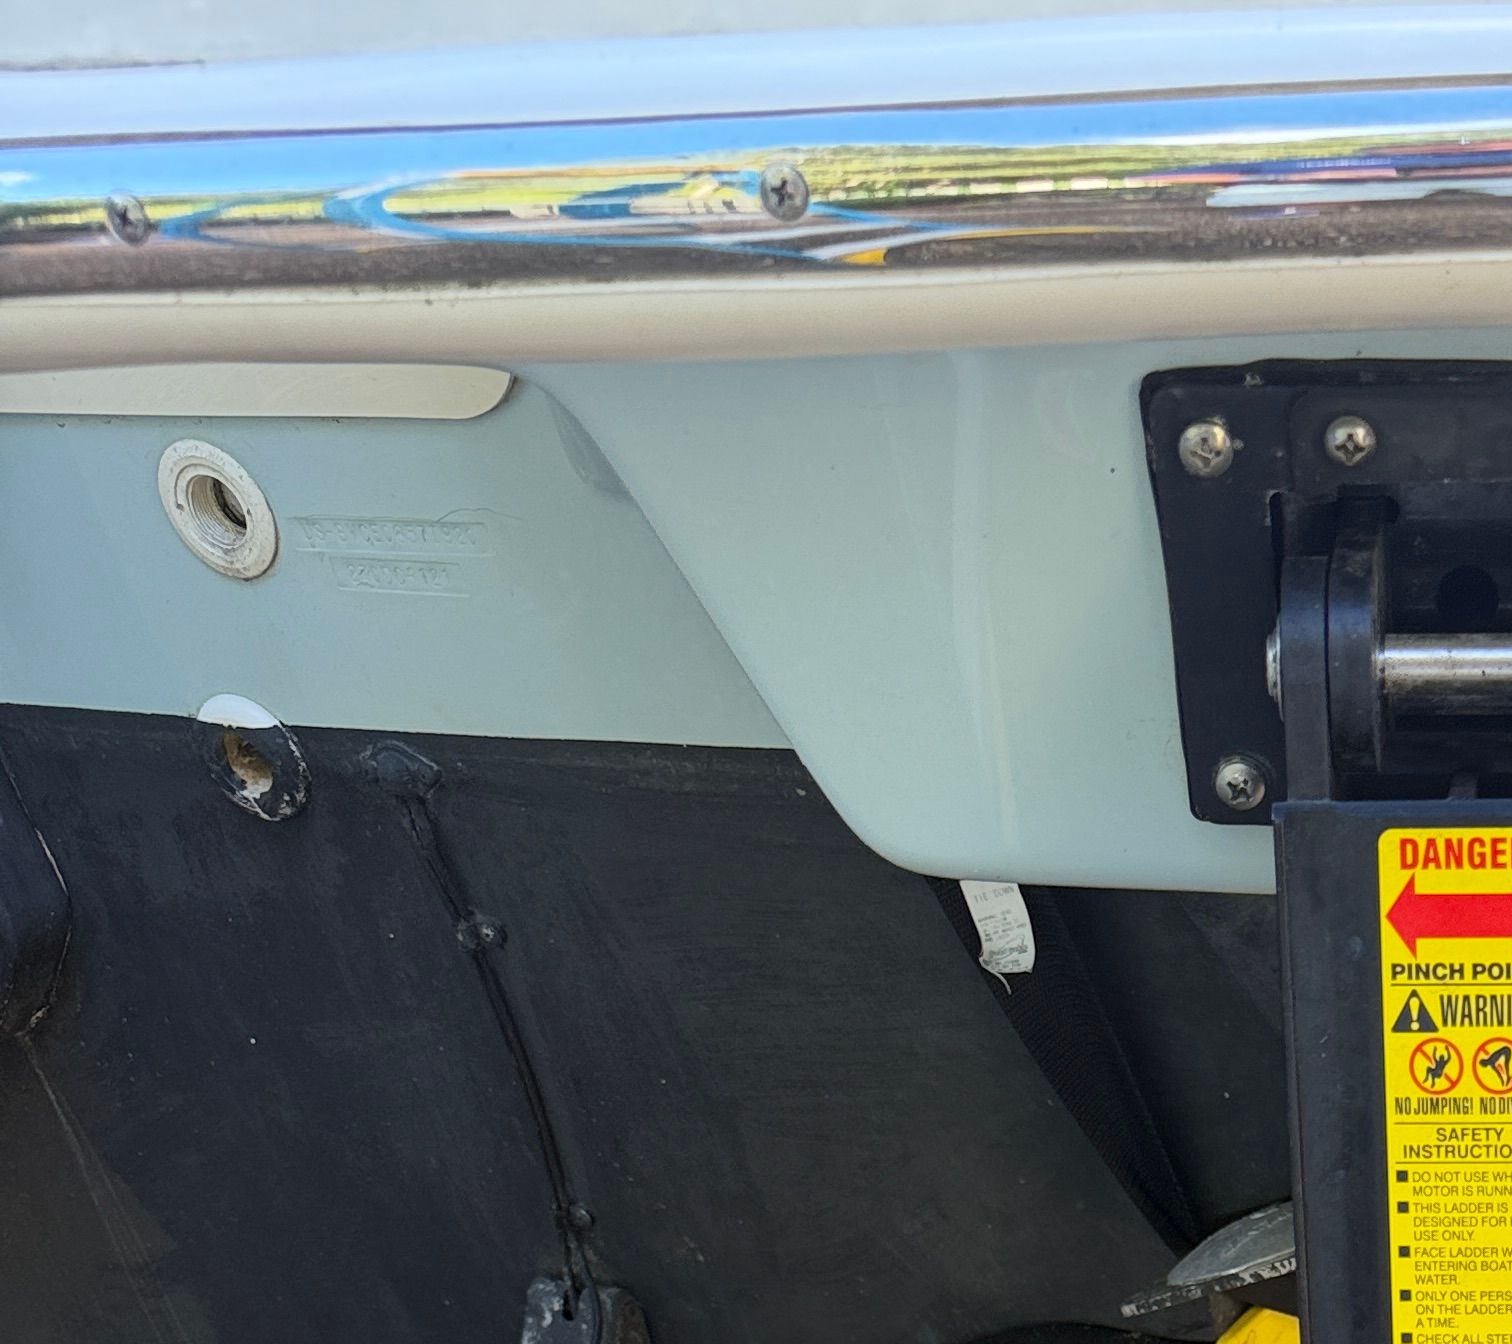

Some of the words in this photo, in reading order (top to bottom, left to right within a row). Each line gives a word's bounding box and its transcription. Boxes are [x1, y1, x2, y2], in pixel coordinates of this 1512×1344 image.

[1391, 963, 1464, 980] PINCH
[1394, 1096, 1413, 1115] NO
[1413, 1096, 1474, 1115] JUMPING!
[1479, 1096, 1498, 1115] NO
[1436, 1127, 1504, 1142] SAFETY
[1412, 1171, 1431, 1183] DO
[1434, 1171, 1461, 1183] NOT
[1463, 1171, 1490, 1183] USE
[1412, 1185, 1459, 1197] MOTOR
[1462, 1185, 1474, 1197] IS
[1412, 1202, 1441, 1214] THIS
[1444, 1202, 1494, 1214] LADDER
[1497, 1202, 1509, 1214] IS
[1413, 1216, 1478, 1228] DESIGNED
[1481, 1216, 1507, 1228] FOR
[1413, 1230, 1439, 1241] USE
[1414, 1247, 1447, 1258] FACE
[1449, 1247, 1499, 1258] LADDER
[1414, 1260, 1477, 1272] ENTERING
[1415, 1274, 1460, 1285] WATER.
[1415, 1290, 1447, 1302] ONLY
[1450, 1290, 1476, 1302] ONE
[1415, 1304, 1434, 1315] ON
[1437, 1304, 1461, 1315] THE
[1464, 1304, 1512, 1315] LADDER
[1415, 1318, 1424, 1328] A
[1426, 1318, 1458, 1328] TIME.
[1416, 1333, 1458, 1344] CHECK
[1461, 1333, 1484, 1344] ALL
